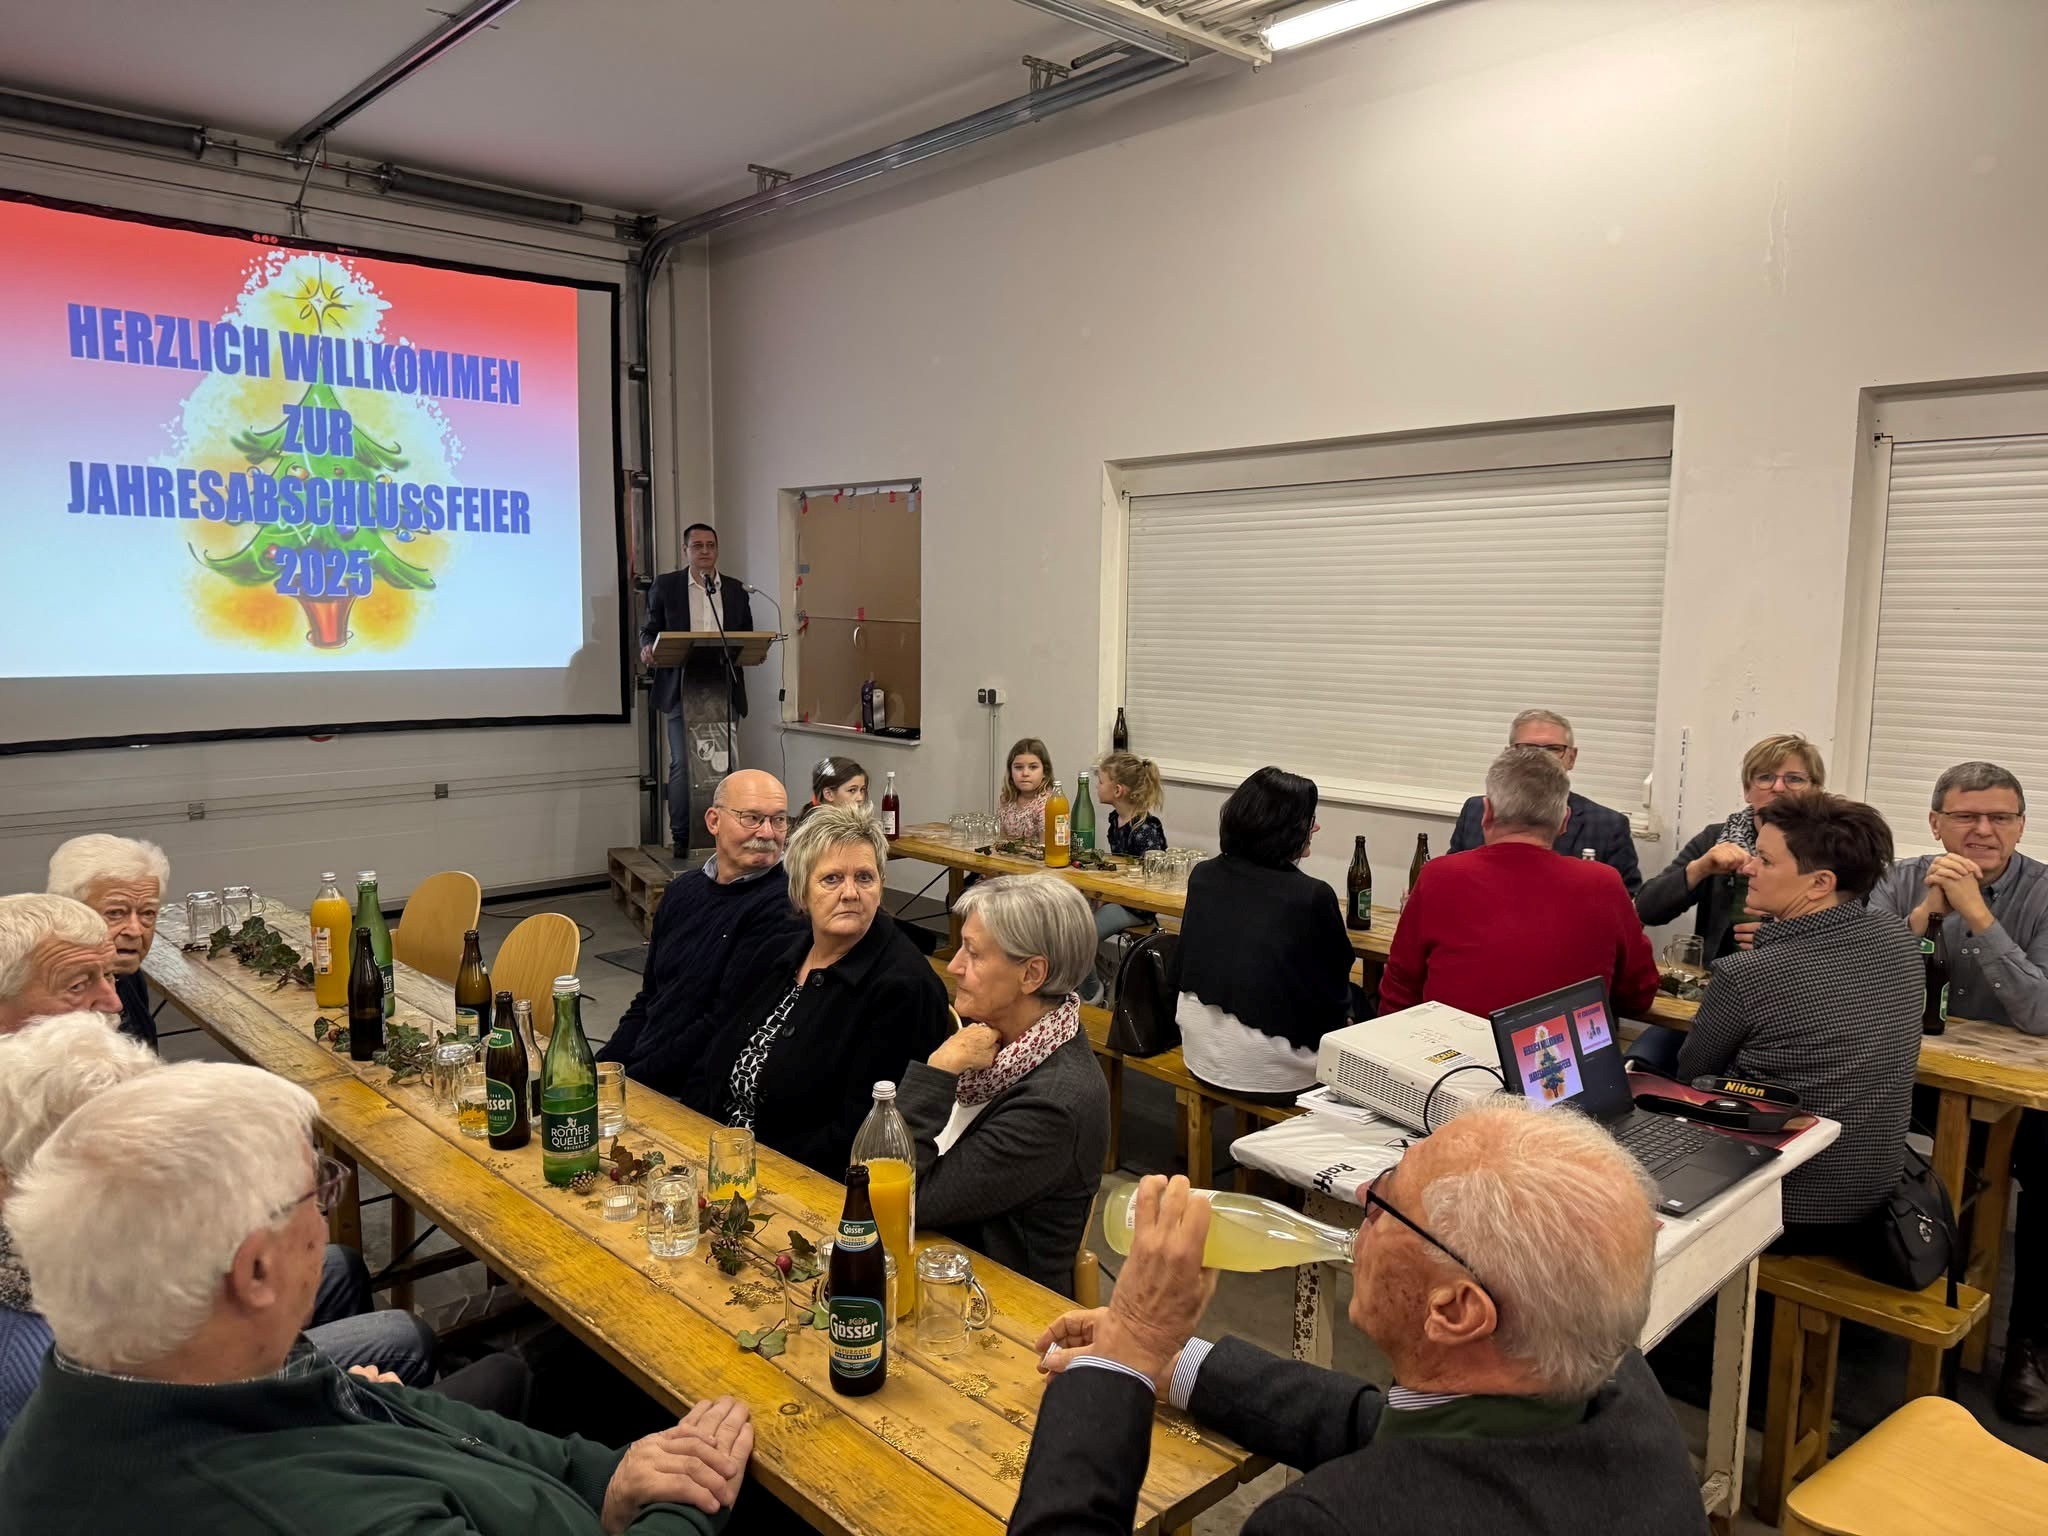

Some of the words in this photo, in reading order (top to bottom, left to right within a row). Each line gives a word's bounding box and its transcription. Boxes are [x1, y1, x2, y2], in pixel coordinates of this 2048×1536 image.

[67, 303, 270, 379] HERZLICH
[279, 331, 521, 405] WILLKOMMEN
[282, 403, 354, 458] ZUR
[67, 461, 531, 534] JAHRESABSCHLUSSFEIER
[274, 548, 374, 597] 2025
[487, 1098, 513, 1111] sser
[1724, 1081, 1765, 1097] Nikon
[551, 1133, 591, 1149] QUELLE
[830, 1313, 879, 1341] Gösser
